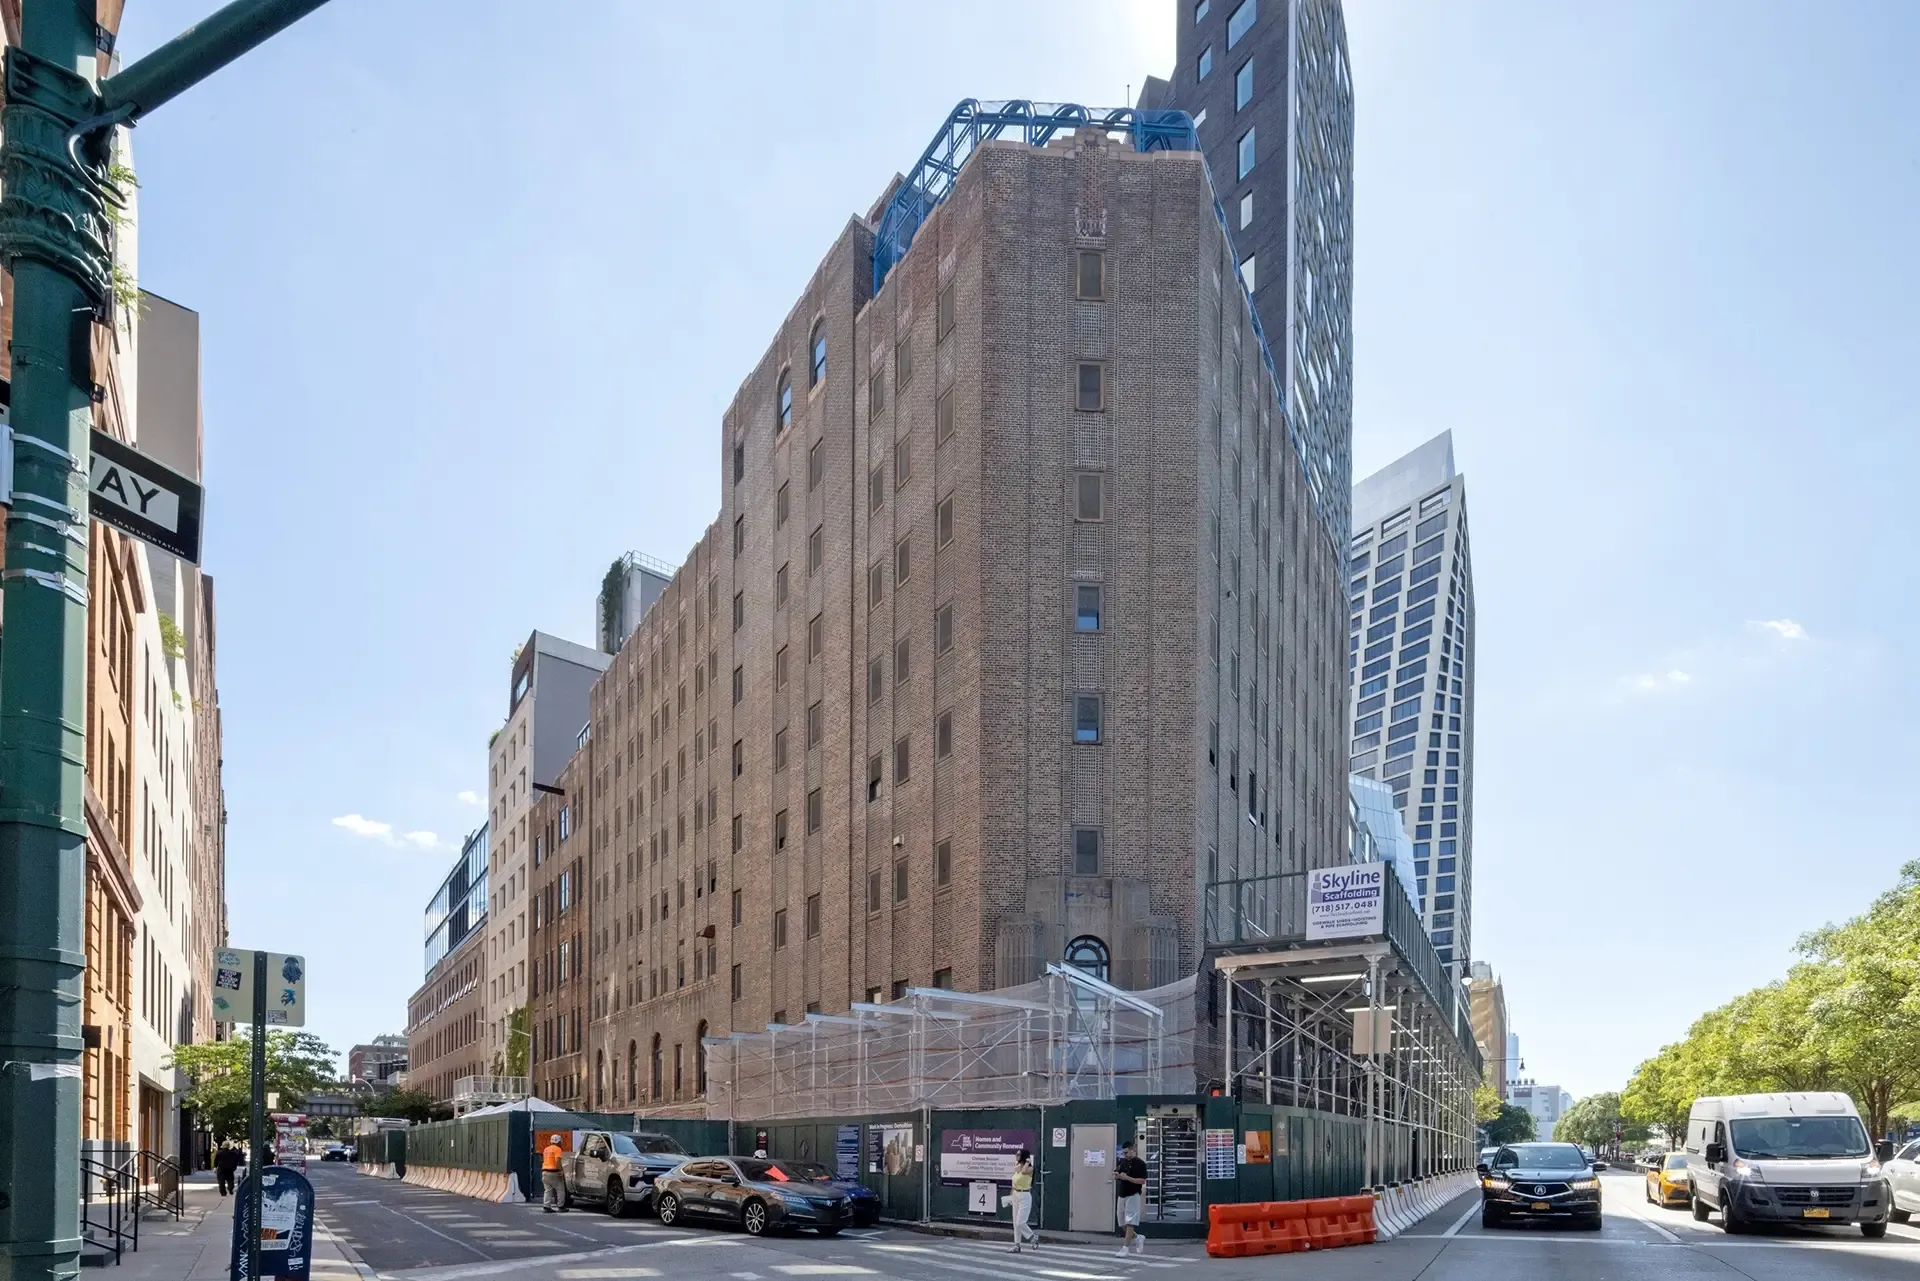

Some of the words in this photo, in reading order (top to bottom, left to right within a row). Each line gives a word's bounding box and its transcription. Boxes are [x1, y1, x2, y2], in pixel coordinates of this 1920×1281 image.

[90, 454, 160, 514] AY
[112, 518, 186, 556] TRANSPORTATION
[1322, 870, 1380, 891] Skyline
[1324, 889, 1377, 900] Scaffolding
[979, 1193, 986, 1206] 4
